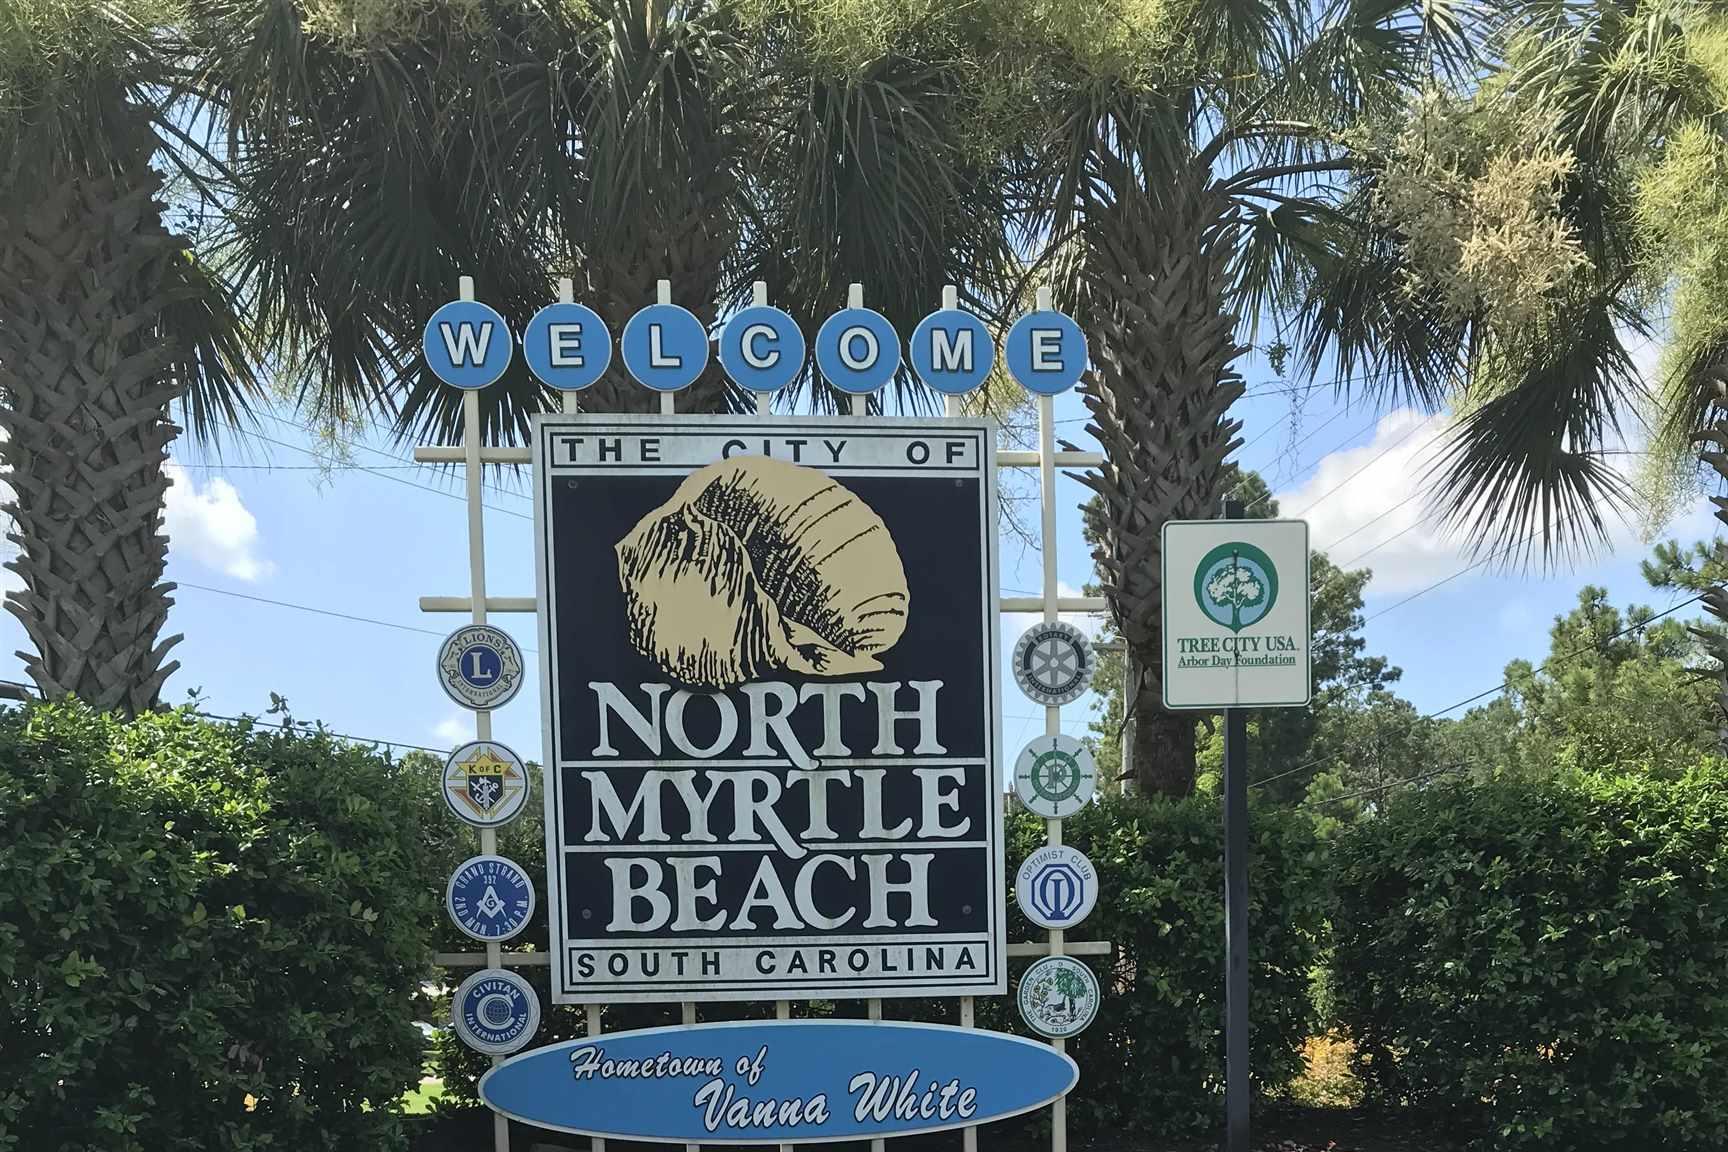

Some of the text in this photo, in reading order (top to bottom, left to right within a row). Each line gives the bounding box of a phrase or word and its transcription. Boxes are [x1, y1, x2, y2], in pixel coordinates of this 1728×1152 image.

[440, 321, 1065, 372] WELCOME
[561, 438, 966, 464] THE CITY OF
[463, 632, 502, 648] LIONS
[1177, 637, 1220, 653] TREE
[1222, 637, 1260, 652] CITY
[471, 652, 492, 678] L
[1178, 654, 1296, 669] Arbor Day Foundation
[588, 680, 947, 769] NORTH
[468, 764, 477, 774] K
[493, 764, 502, 774] C
[581, 768, 970, 859] MYRTLE
[455, 862, 526, 889] GRAND STRAND
[1022, 850, 1092, 881] OPTIMIST CLUB
[454, 896, 469, 917] 2ND
[604, 853, 938, 932] BEACH
[577, 946, 976, 978] SOUTH CAROLINA
[472, 981, 520, 999] CIVITAN
[1023, 977, 1035, 1005] GARDEN
[1072, 965, 1090, 984] SOUTH
[465, 1012, 528, 1042] INTERNATIONAL
[570, 1045, 769, 1086] Hometown of
[693, 1071, 978, 1131] Vanna White
